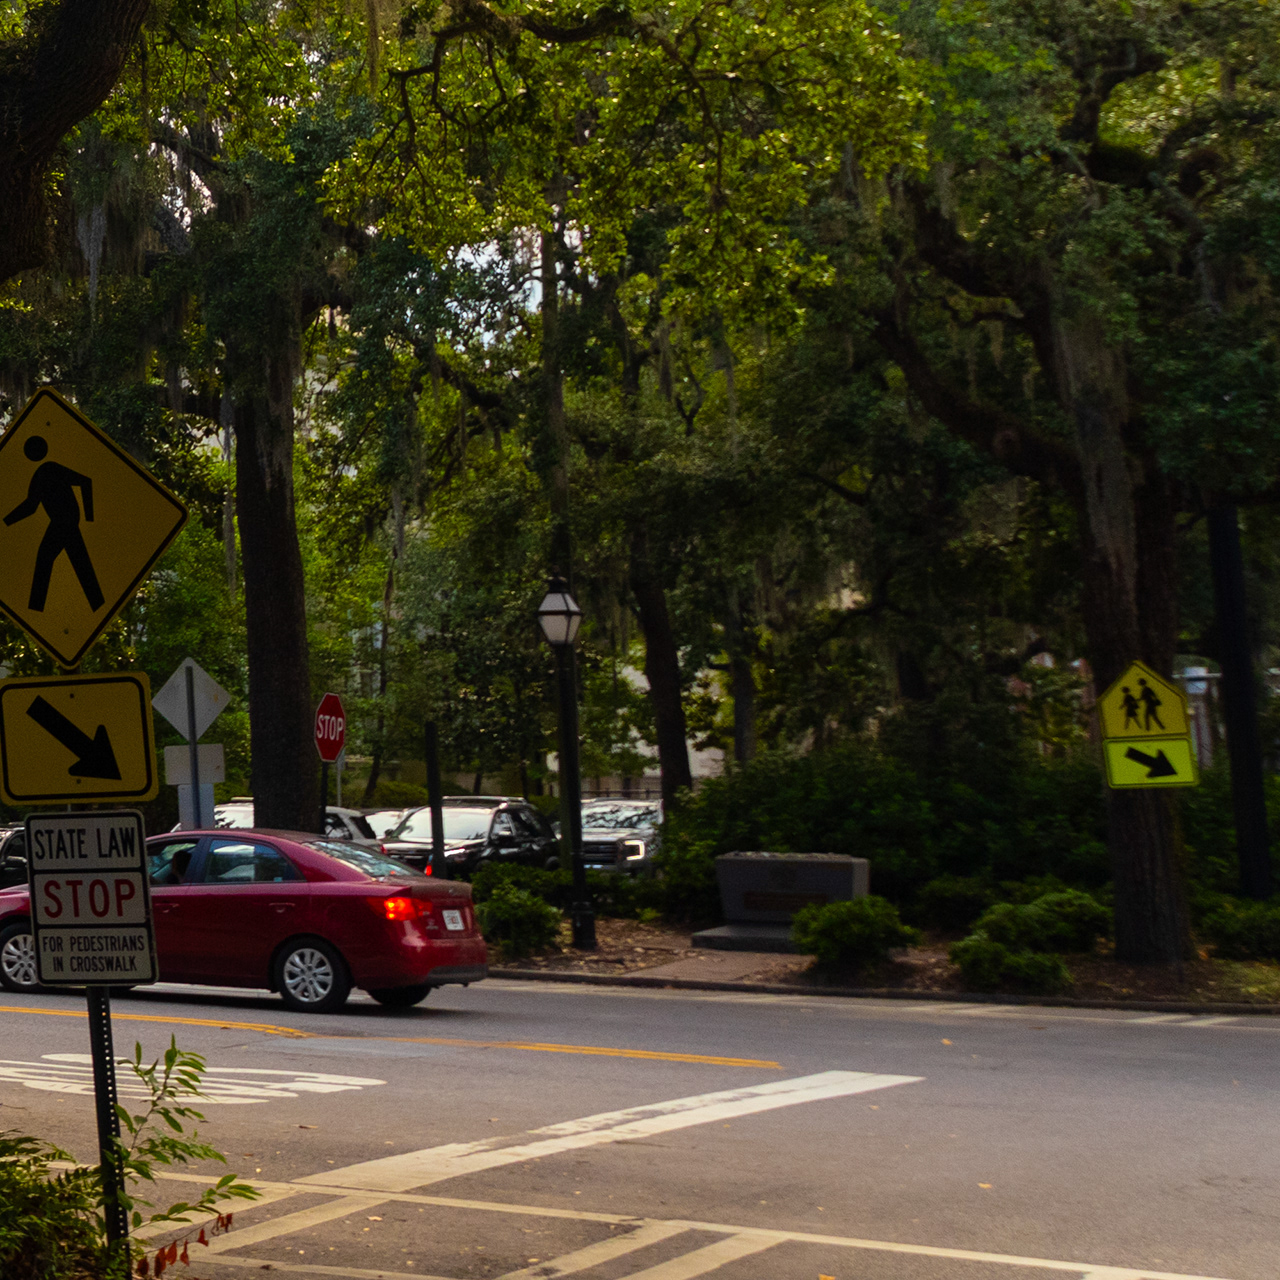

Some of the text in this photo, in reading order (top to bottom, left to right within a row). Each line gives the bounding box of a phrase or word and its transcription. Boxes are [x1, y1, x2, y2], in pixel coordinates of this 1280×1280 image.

[317, 714, 344, 741] STOP
[34, 827, 135, 860] STATE LAW
[44, 879, 136, 918] STOP
[42, 935, 145, 952] FOR PEDESTRIANS
[53, 956, 137, 972] IN CROSSWALK
